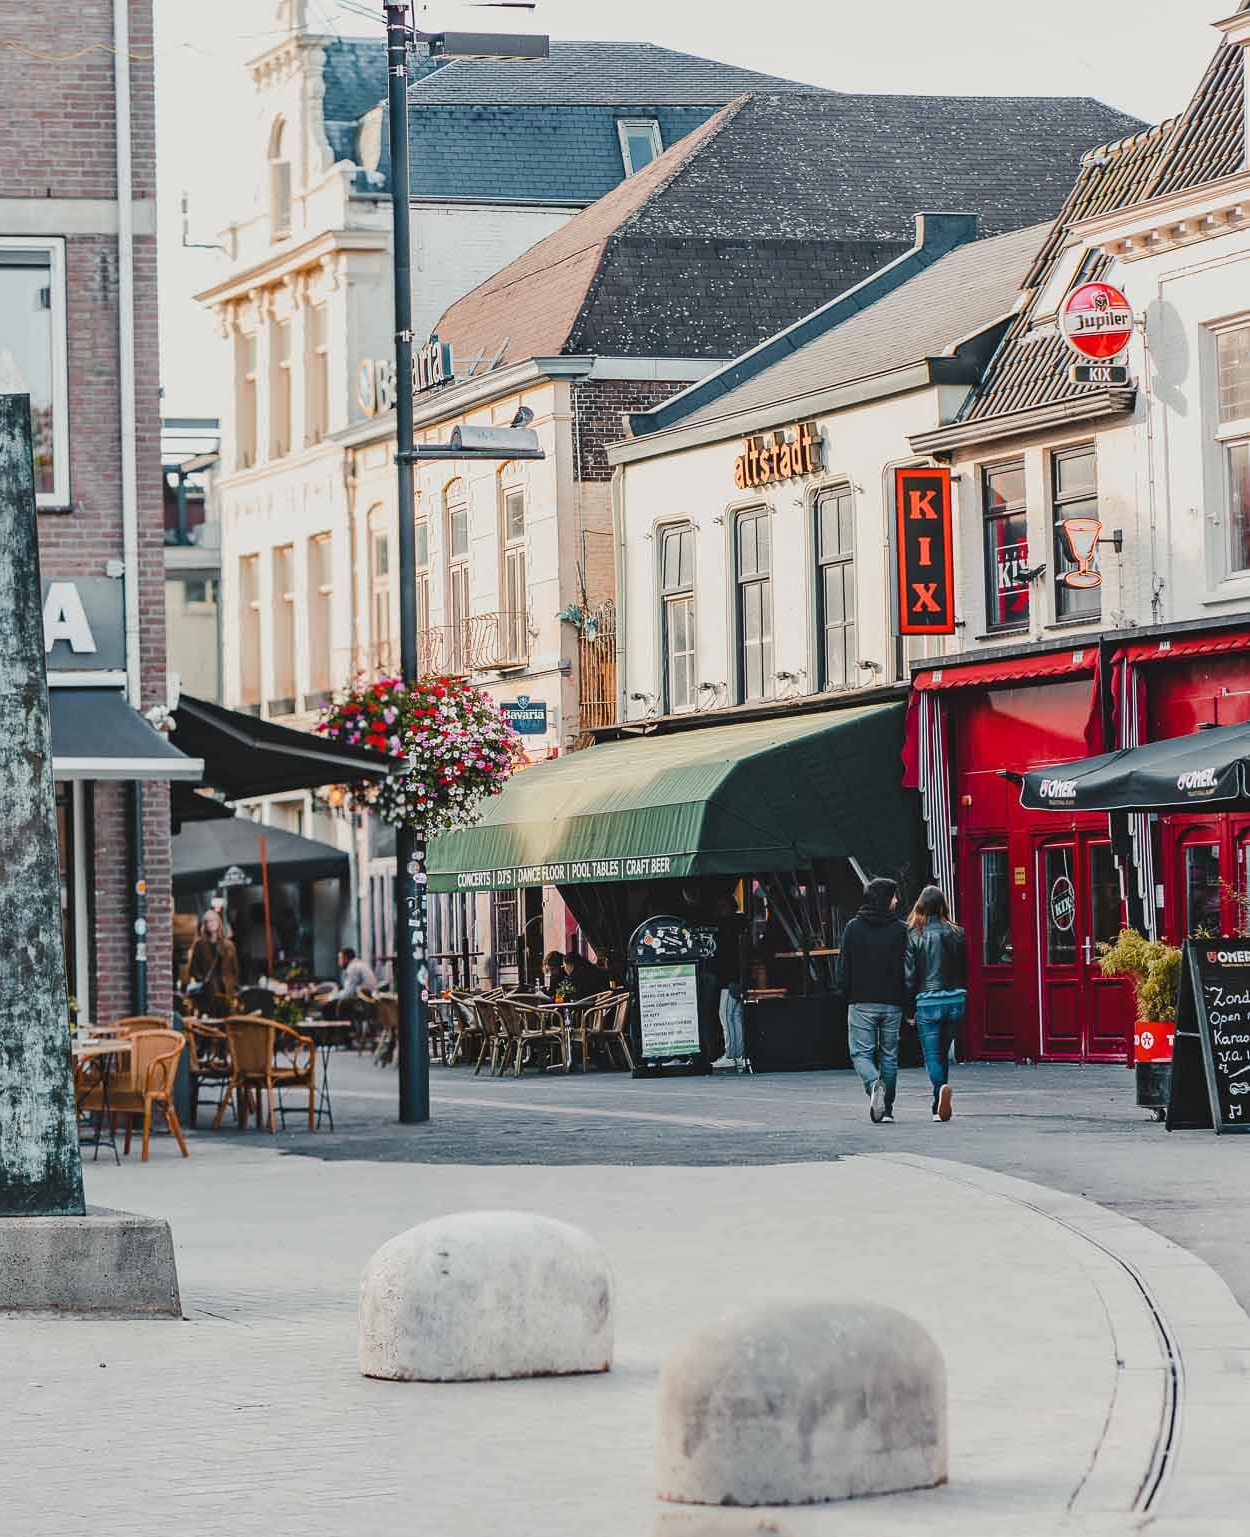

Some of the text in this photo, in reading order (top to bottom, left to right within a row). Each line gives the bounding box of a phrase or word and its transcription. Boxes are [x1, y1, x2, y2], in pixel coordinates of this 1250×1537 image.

[1076, 311, 1129, 330] Jupiler
[1089, 367, 1112, 382] KIX
[734, 423, 814, 490] altstadt
[909, 490, 942, 613] KIX
[503, 710, 545, 720] Bavaria
[457, 857, 670, 887] CONCERTS DJ'S DANCE FLOOR POOL TABLES CRAFT BEER
[1055, 897, 1071, 917] KIX
[1210, 986, 1250, 1007] Zond
[1210, 1011, 1240, 1030] Open
[1214, 1029, 1250, 1045] Karao
